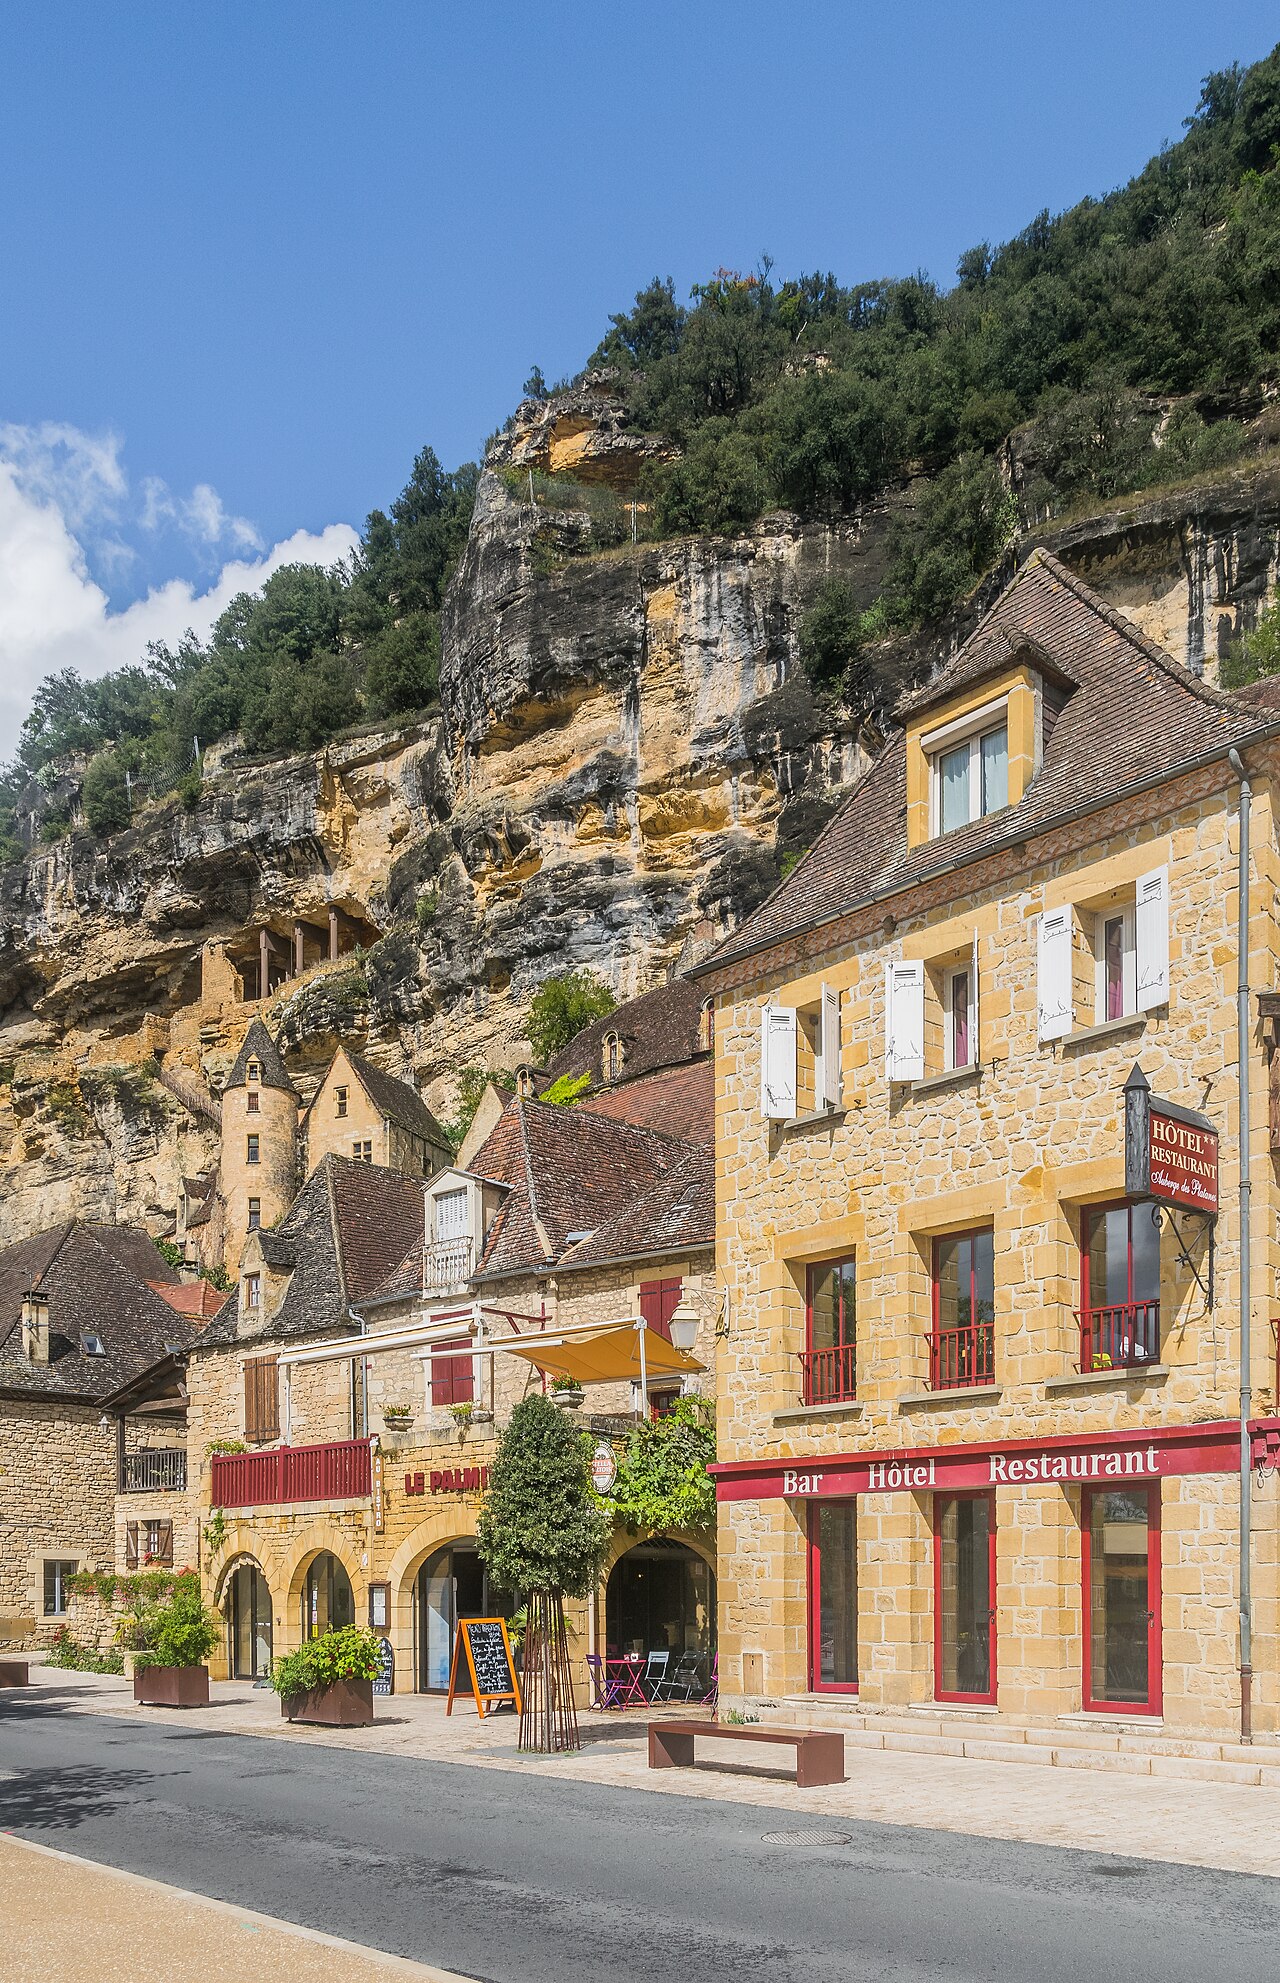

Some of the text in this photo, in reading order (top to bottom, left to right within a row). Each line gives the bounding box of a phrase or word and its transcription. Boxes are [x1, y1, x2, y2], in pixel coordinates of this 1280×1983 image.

[1152, 1119, 1205, 1155] HÔTEL
[1151, 1145, 1217, 1180] RESTAURANT
[1151, 1169, 1217, 1203] Auberge des Platanes
[375, 1457, 382, 1473] AU
[782, 1445, 1160, 1495] Bar Hôtel Restaurant
[405, 1472, 425, 1494] LE
